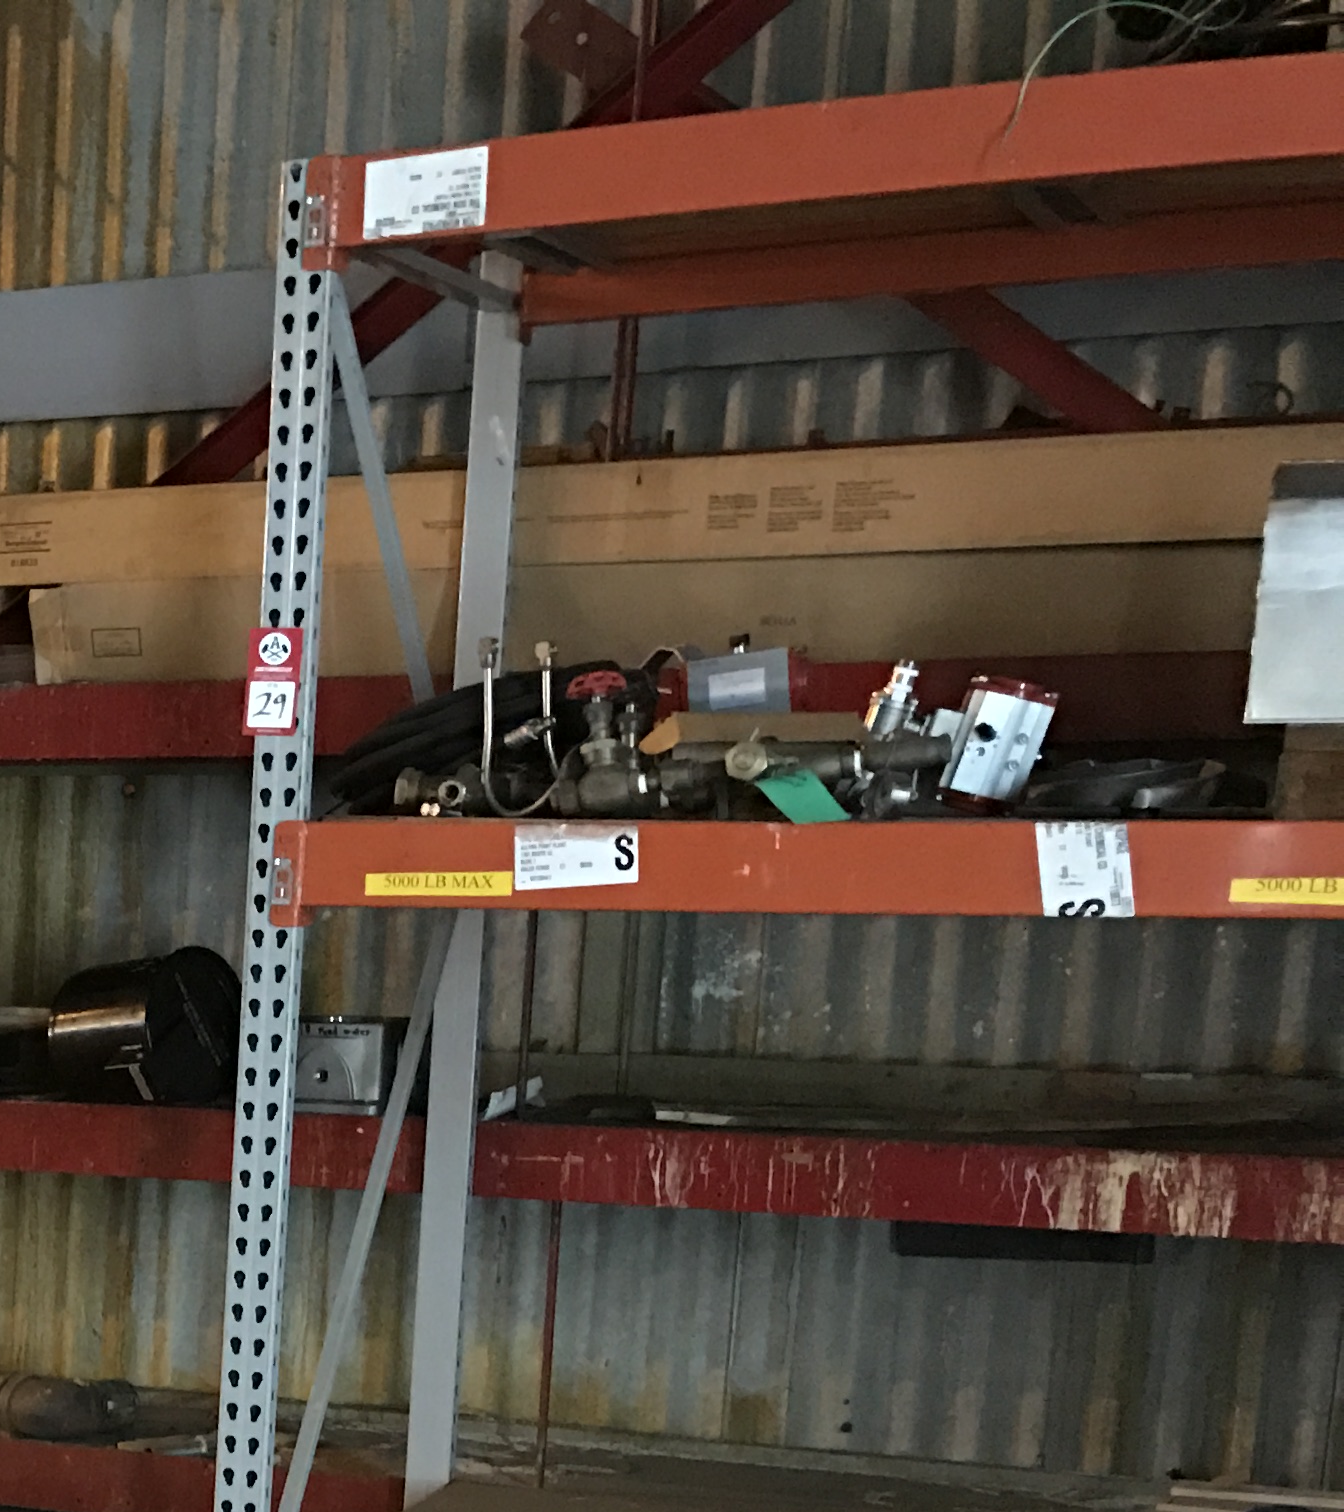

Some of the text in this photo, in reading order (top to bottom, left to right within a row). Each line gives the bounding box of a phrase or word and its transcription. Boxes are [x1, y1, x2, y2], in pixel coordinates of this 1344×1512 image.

[252, 692, 287, 719] 29
[614, 834, 635, 871] S
[384, 873, 494, 890] 5000 LB MAX
[1254, 877, 1338, 894] 5000 LB
